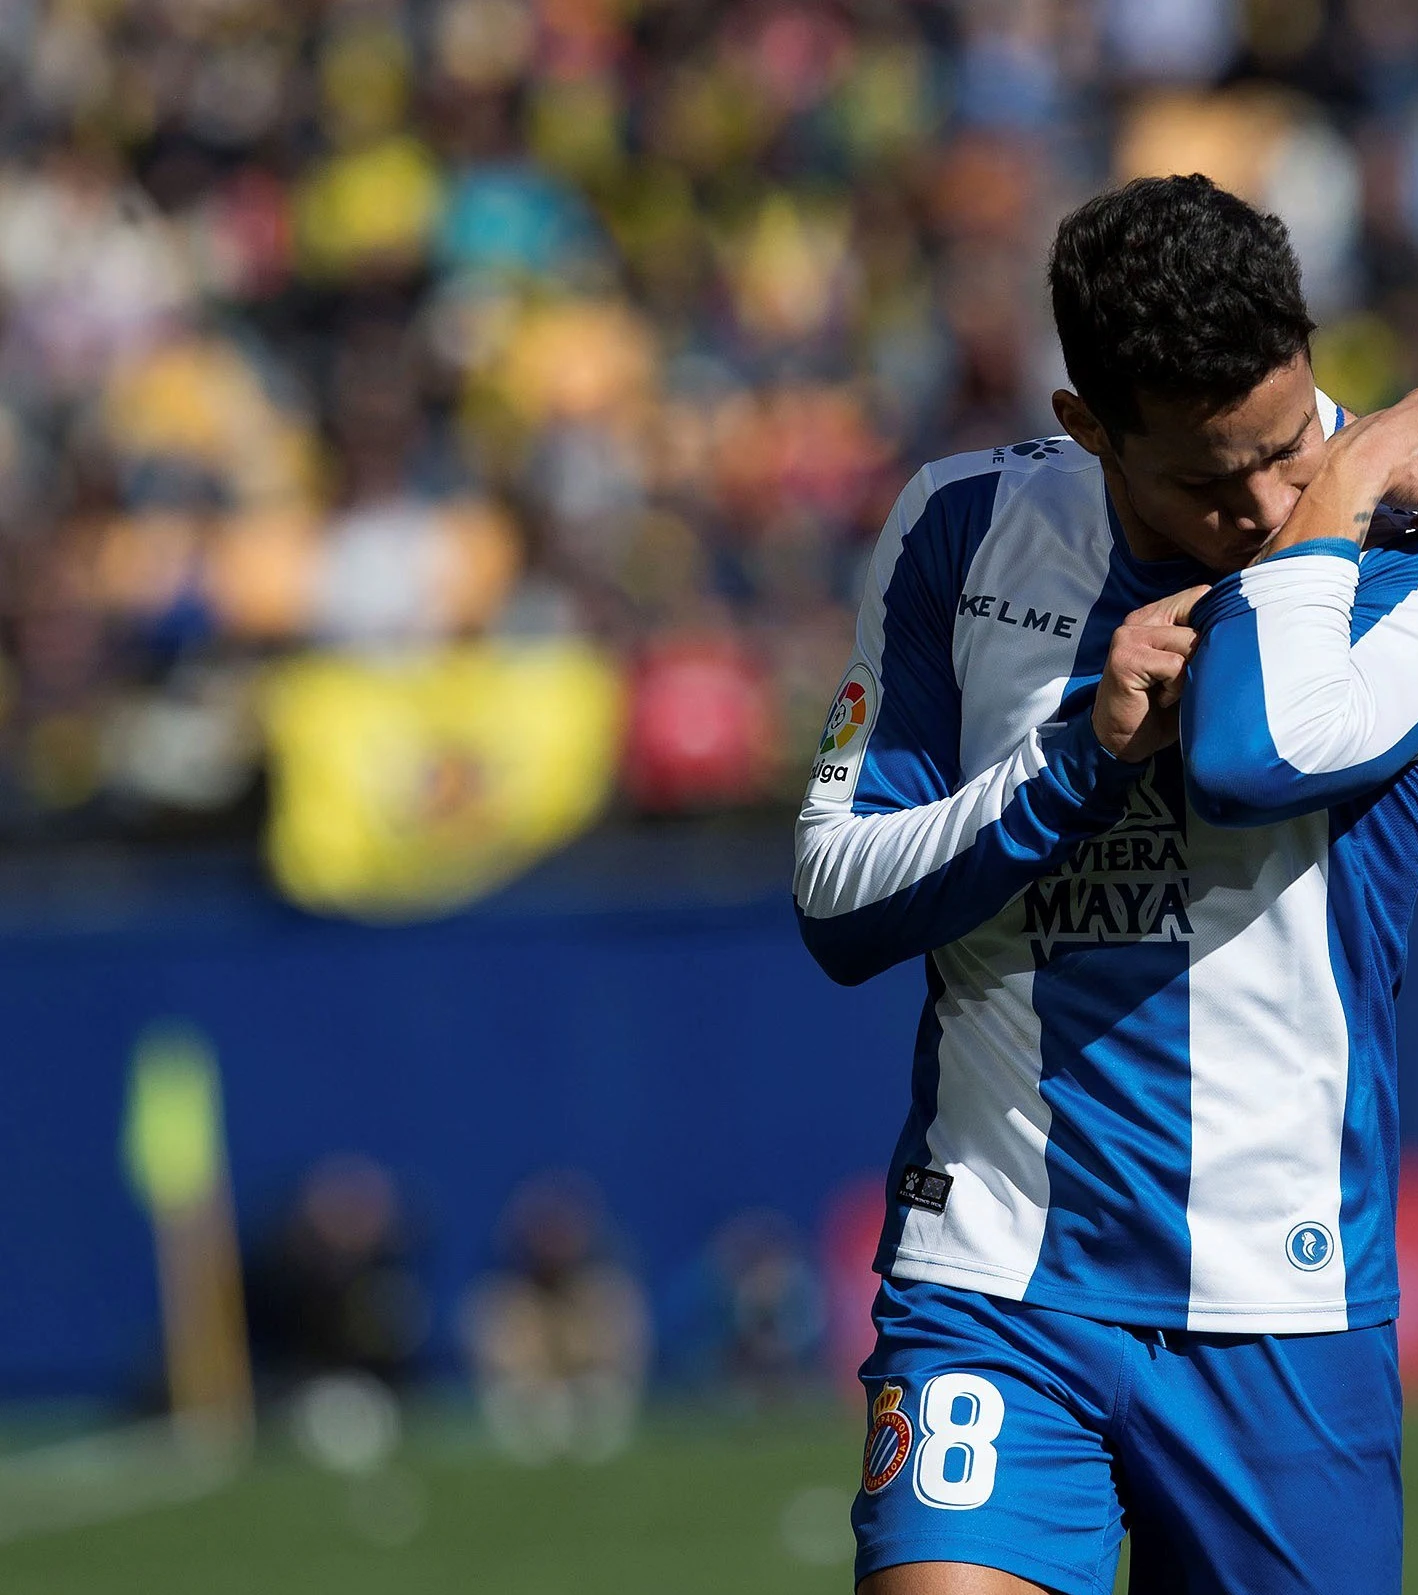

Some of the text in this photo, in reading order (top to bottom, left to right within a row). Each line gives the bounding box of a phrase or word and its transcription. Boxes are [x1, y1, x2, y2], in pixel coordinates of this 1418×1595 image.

[958, 593, 1078, 639] KELME
[1022, 877, 1195, 941] MAYA
[912, 1373, 1006, 1511] 8
